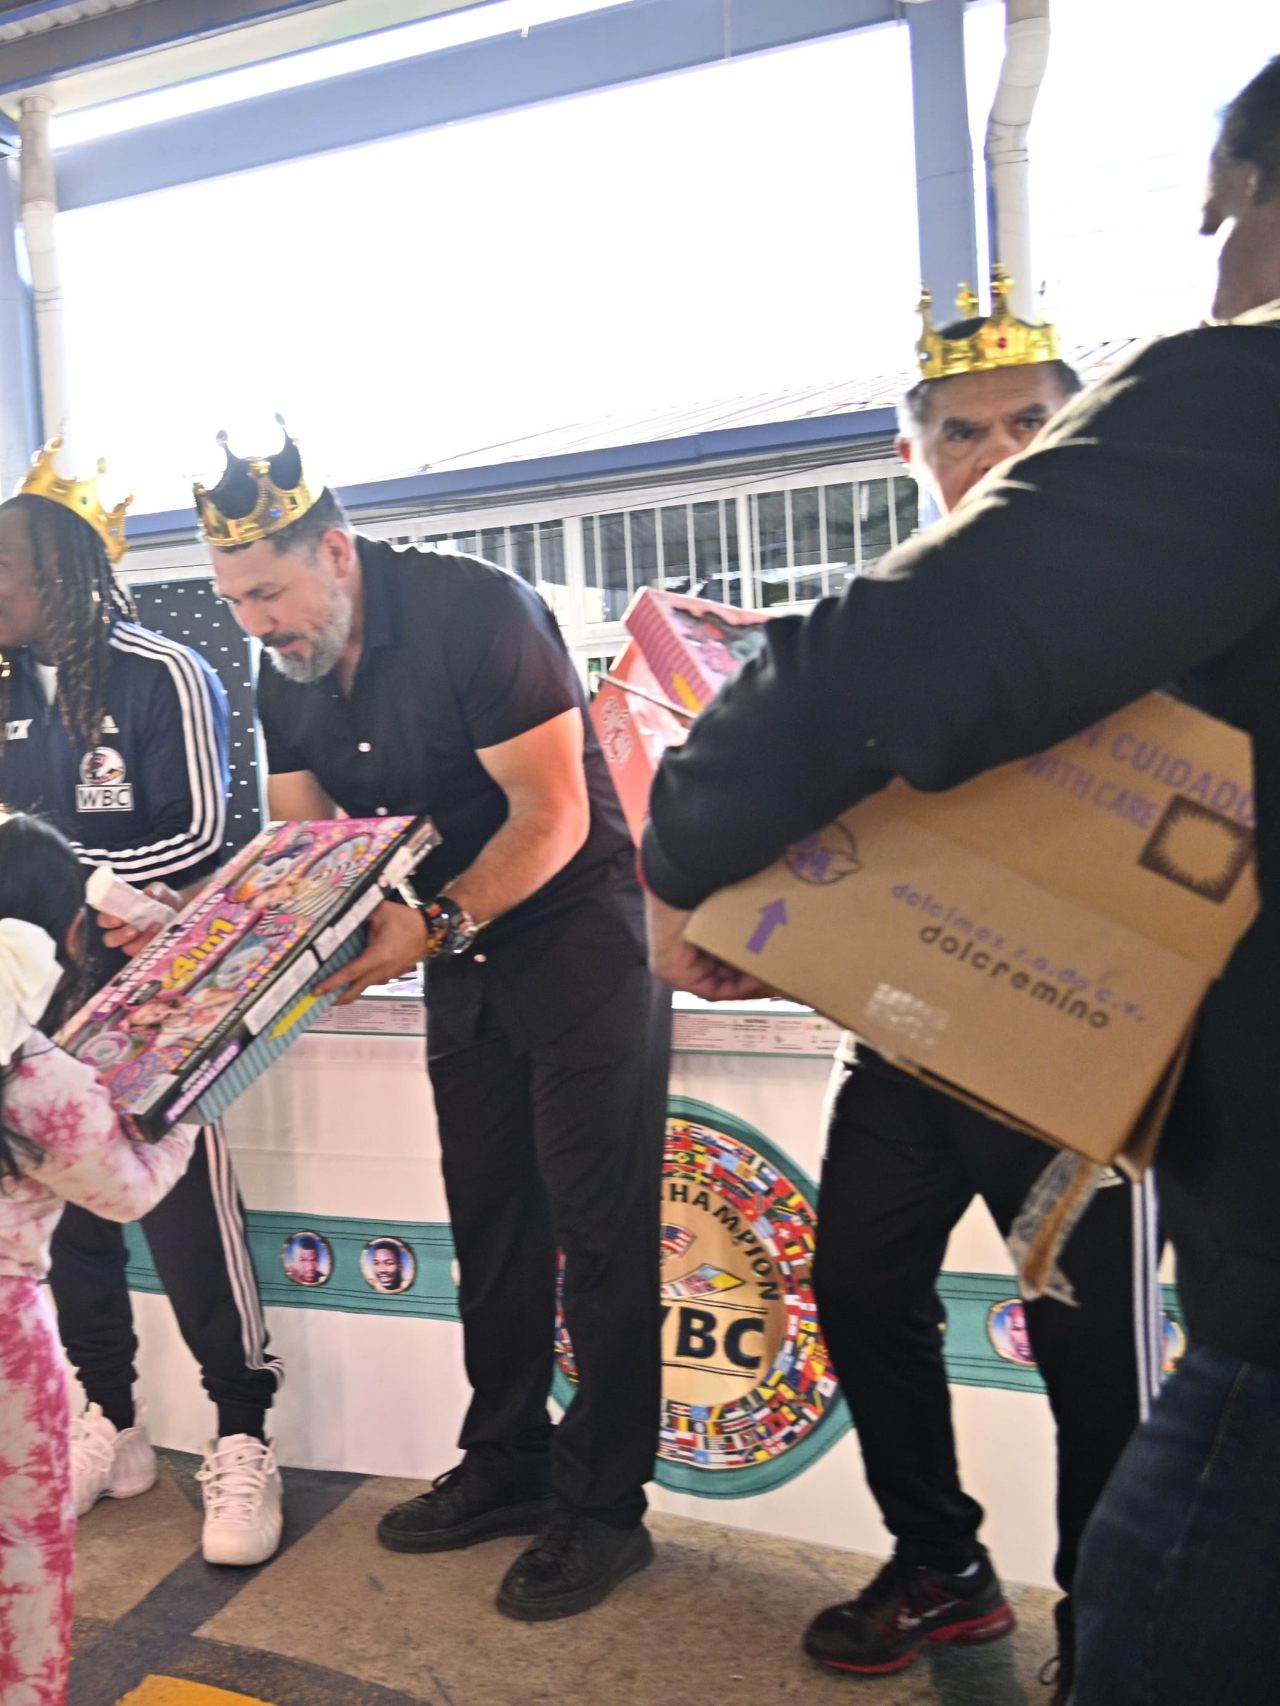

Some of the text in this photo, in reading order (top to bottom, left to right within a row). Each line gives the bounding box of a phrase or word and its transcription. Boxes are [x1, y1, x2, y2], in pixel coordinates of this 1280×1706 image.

[79, 788, 130, 807] WBC
[1092, 781, 1159, 832] CARE
[95, 891, 227, 1013] PERSONALIZED
[661, 1182, 781, 1301] HAMPION
